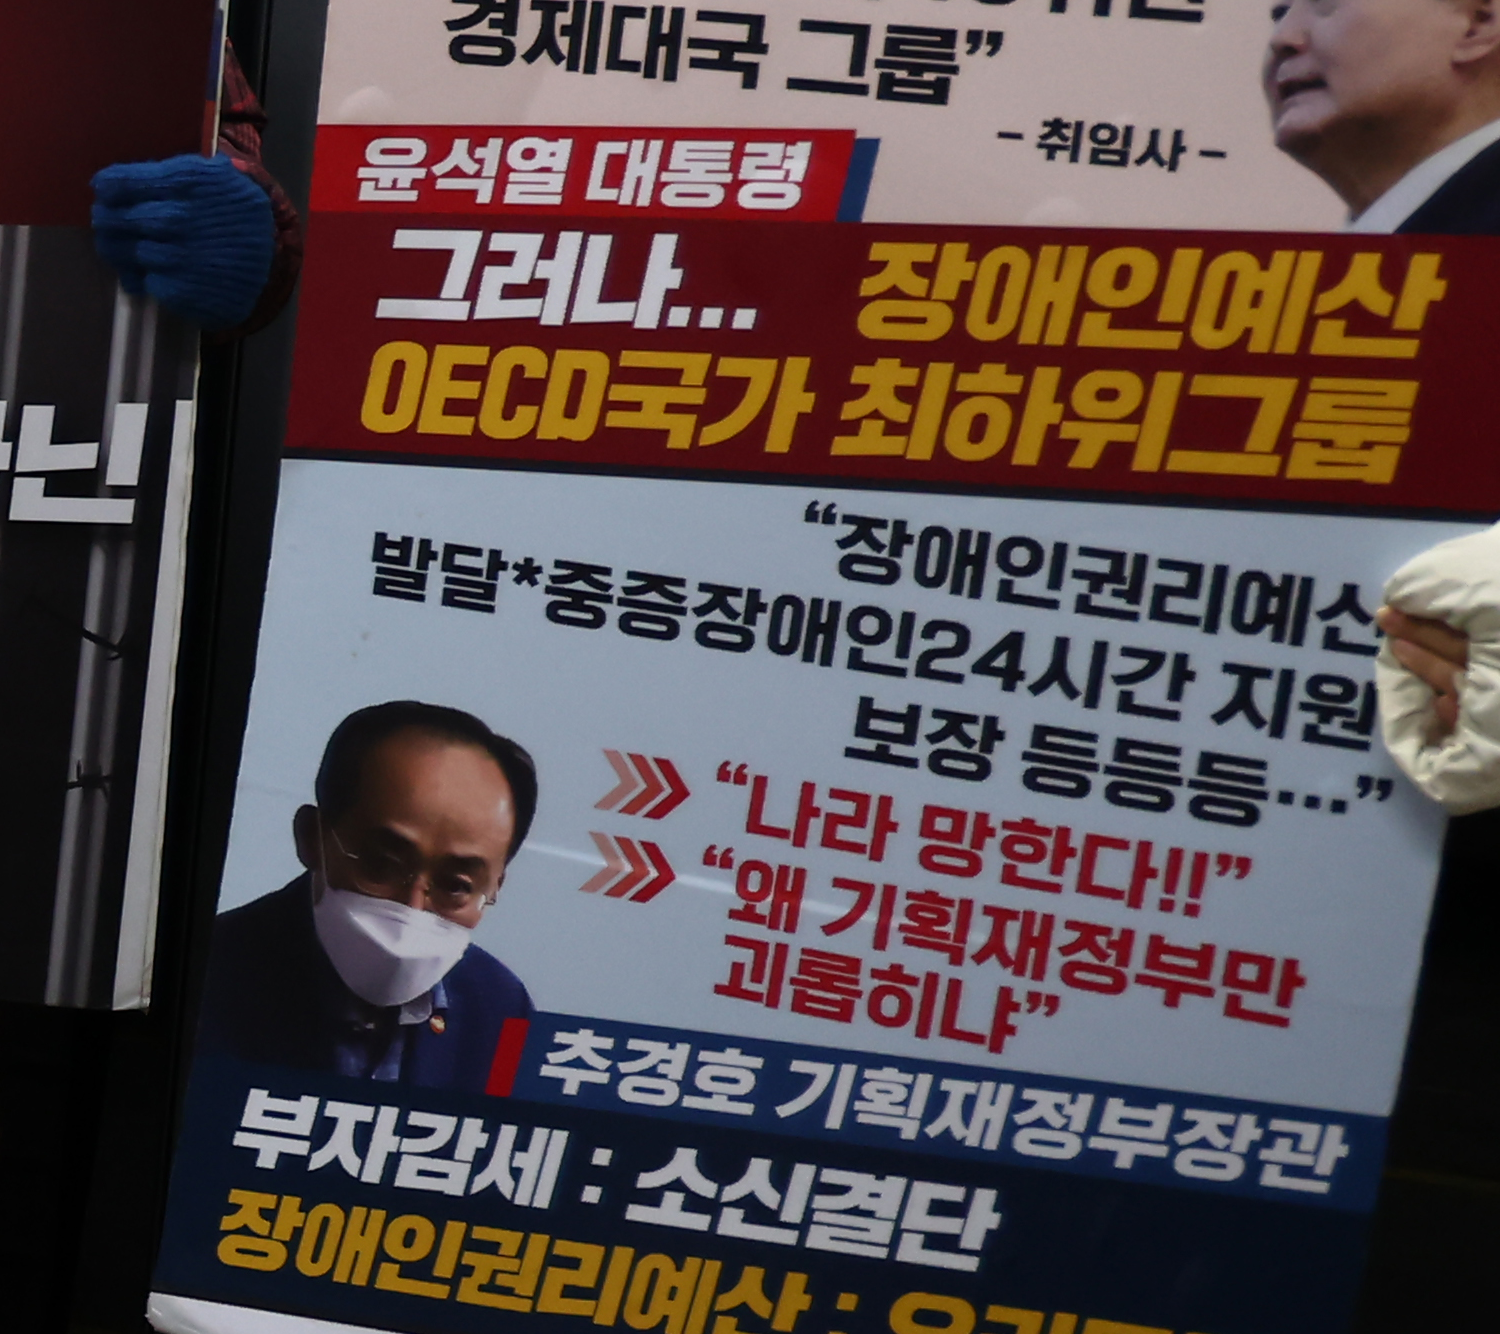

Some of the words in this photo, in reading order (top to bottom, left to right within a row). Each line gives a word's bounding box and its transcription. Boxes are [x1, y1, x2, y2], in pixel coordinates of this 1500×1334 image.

[785, 24, 1005, 105] 그룹”
[356, 133, 566, 207] 윤석열
[587, 136, 811, 212] 대통령
[1035, 117, 1187, 175] 취임사
[375, 226, 757, 331] 그러나...
[856, 241, 1447, 360] 장애인예산
[360, 339, 814, 455] OECD국가
[833, 358, 1421, 486] 최하위그룹
[843, 692, 1003, 783] 보장
[1211, 662, 1377, 752] 지원
[716, 759, 896, 862] “나라
[919, 805, 1251, 921] 망한다!!”
[703, 844, 806, 937] “왜
[822, 873, 1307, 1028] 기획재정부만
[714, 940, 1059, 1055] 괴롭히냐”
[538, 1027, 757, 1117] 추경호
[775, 1042, 1350, 1195] 기획재정부장관
[230, 1089, 568, 1210] 부자감세
[623, 1145, 1001, 1272] 소신결단
